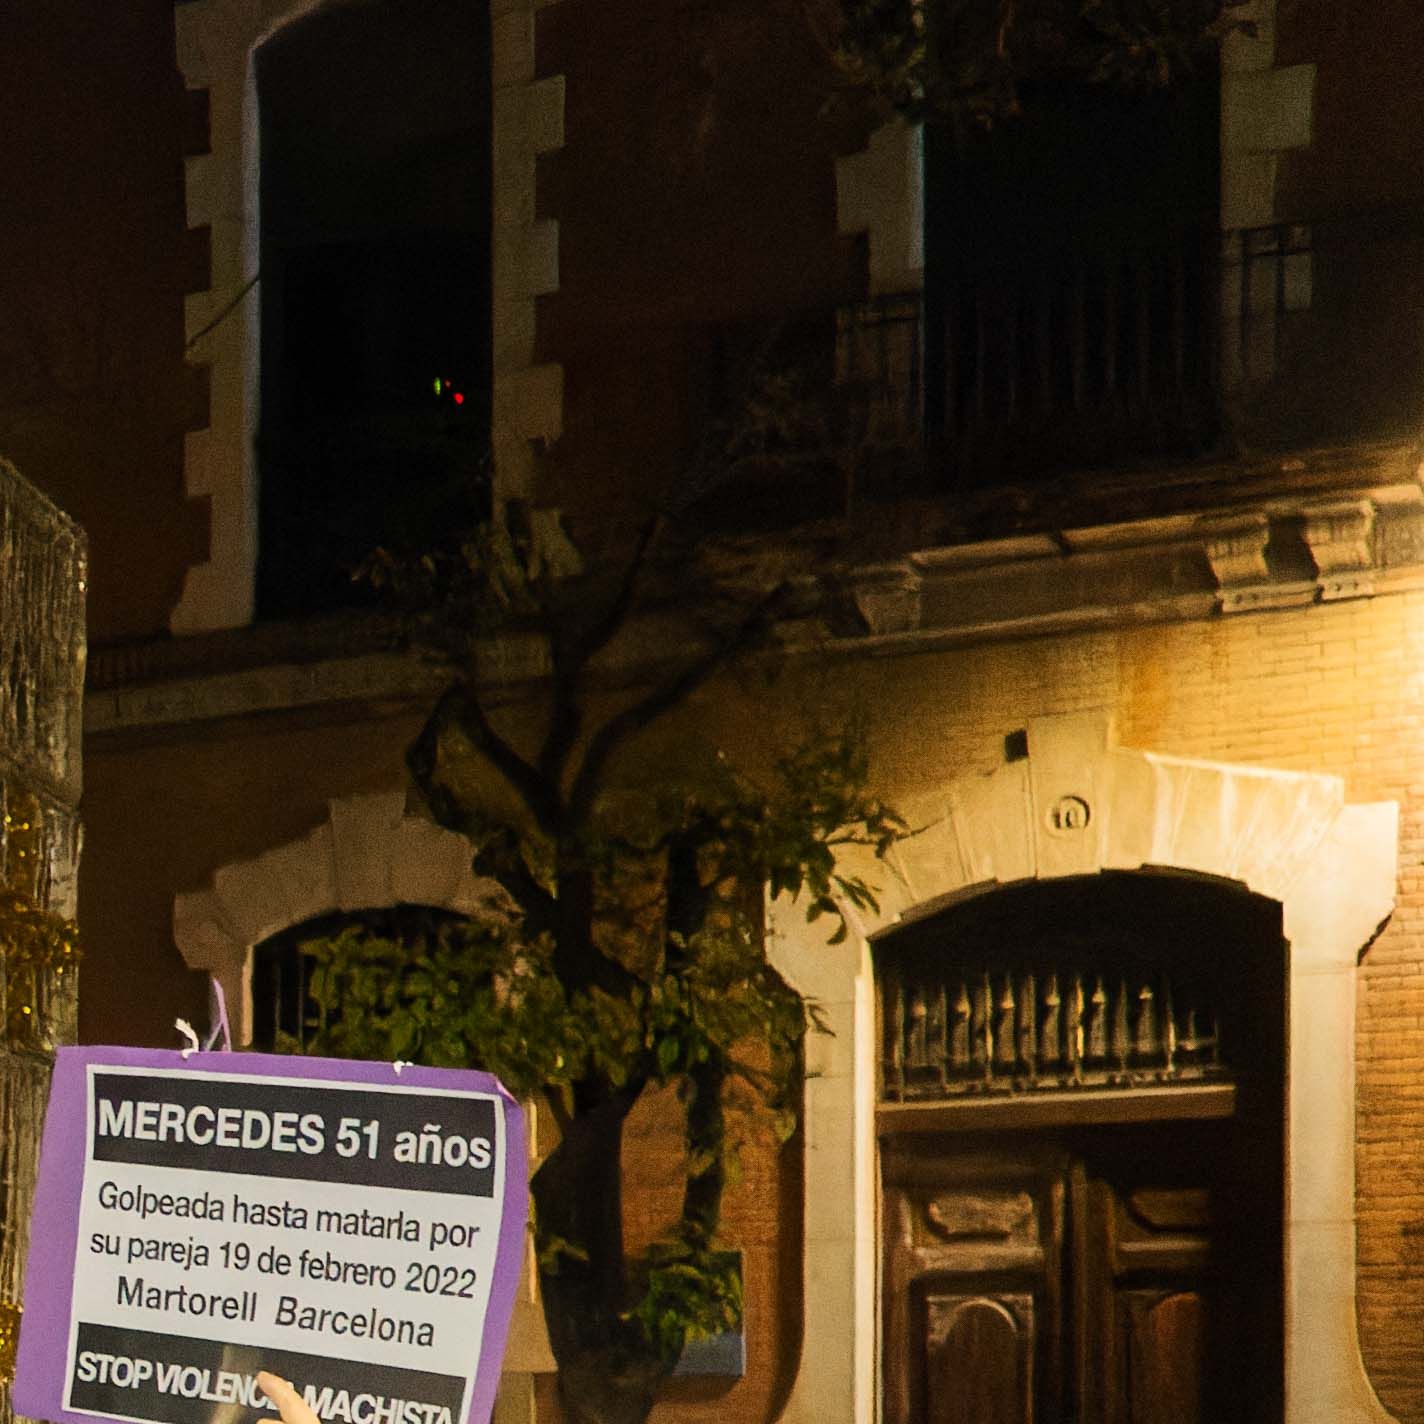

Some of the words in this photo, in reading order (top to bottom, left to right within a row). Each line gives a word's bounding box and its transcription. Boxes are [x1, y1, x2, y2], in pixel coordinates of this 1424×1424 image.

[98, 1099, 324, 1155] MERCEDES
[335, 1120, 382, 1159] 51
[393, 1122, 492, 1169] años
[98, 1181, 225, 1223] Golpeada
[233, 1195, 307, 1231] hasta
[316, 1208, 420, 1244] matarla
[429, 1224, 480, 1255] por
[90, 1233, 121, 1256] su
[127, 1238, 210, 1273] pareja
[219, 1241, 249, 1271] 19
[257, 1247, 292, 1277] de
[298, 1251, 396, 1289] febrero
[406, 1264, 476, 1300] 2022
[117, 1276, 258, 1324] Martorell
[275, 1296, 434, 1348] Barcelona
[76, 1350, 153, 1390] STOP
[155, 1361, 300, 1410] VIOLENC
